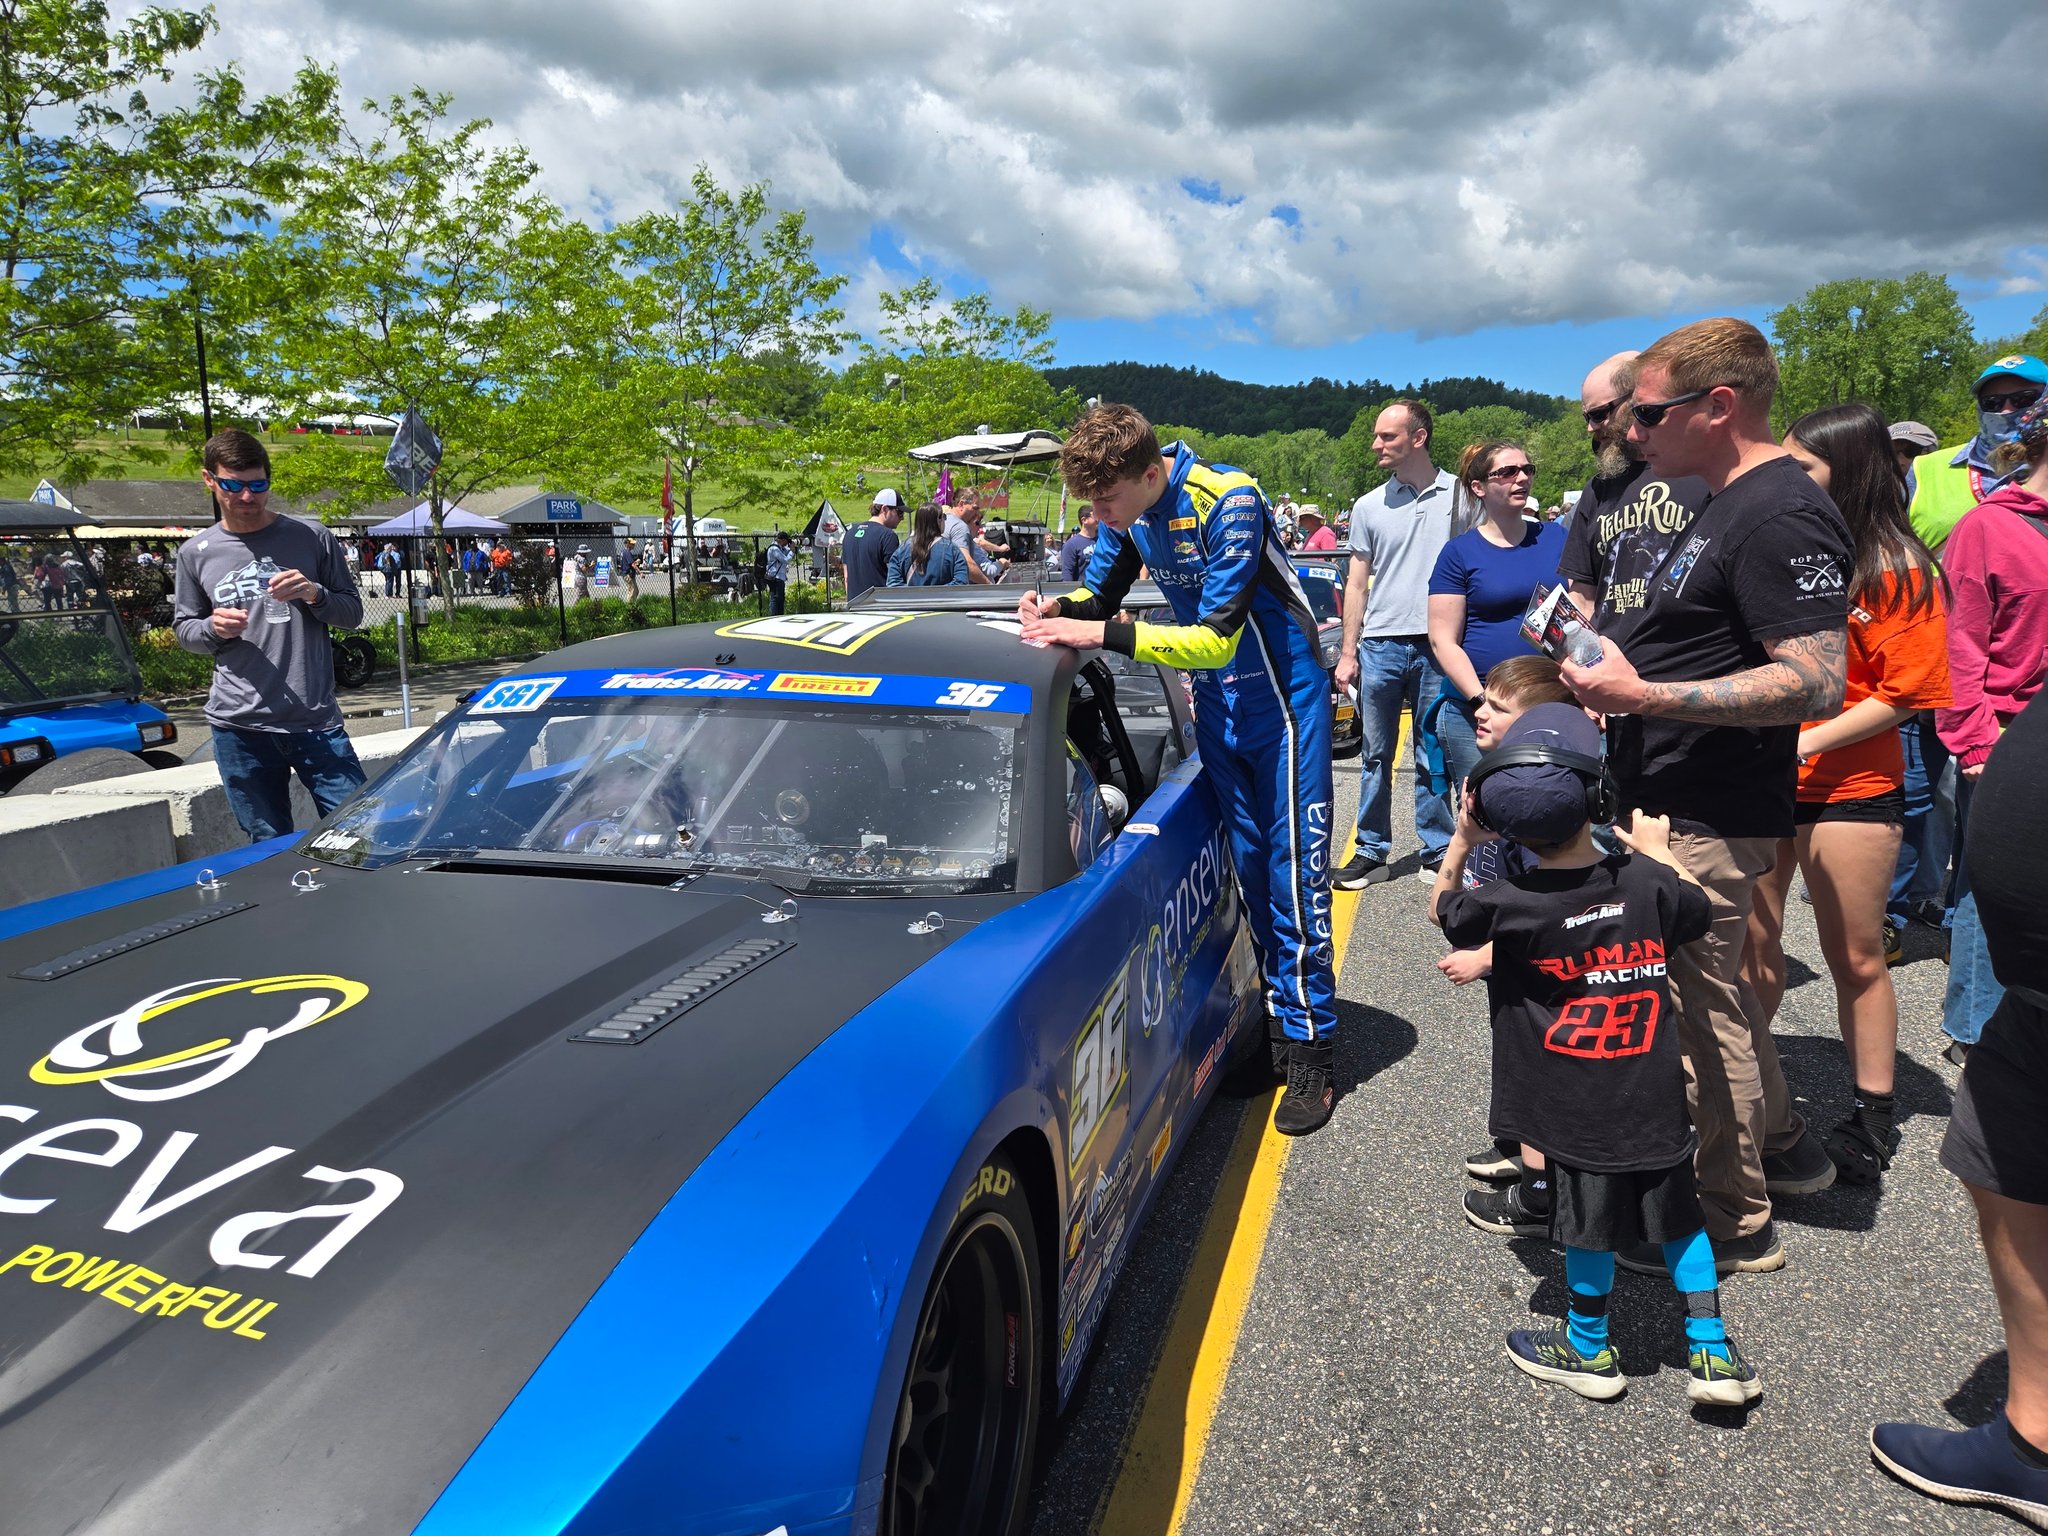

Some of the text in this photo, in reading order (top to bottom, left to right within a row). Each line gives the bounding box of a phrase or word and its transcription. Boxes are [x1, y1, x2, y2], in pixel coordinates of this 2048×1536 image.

[551, 501, 577, 510] PARK
[1596, 500, 1645, 556] JELLY
[1790, 555, 1812, 565] POP
[214, 579, 262, 604] CR
[600, 673, 687, 690] Trans
[689, 675, 752, 691] Am
[779, 677, 870, 693] PIRELLI
[935, 681, 1006, 708] 36
[482, 683, 556, 709] SGT
[1306, 801, 1332, 938] enseva
[1563, 905, 1625, 930] Trans Am
[1537, 938, 1666, 980] RUMAN
[1583, 962, 1668, 985] RACING
[1543, 989, 1661, 1059] 23
[1071, 978, 1126, 1164] 36
[0, 1244, 279, 1340] POWERFUL
